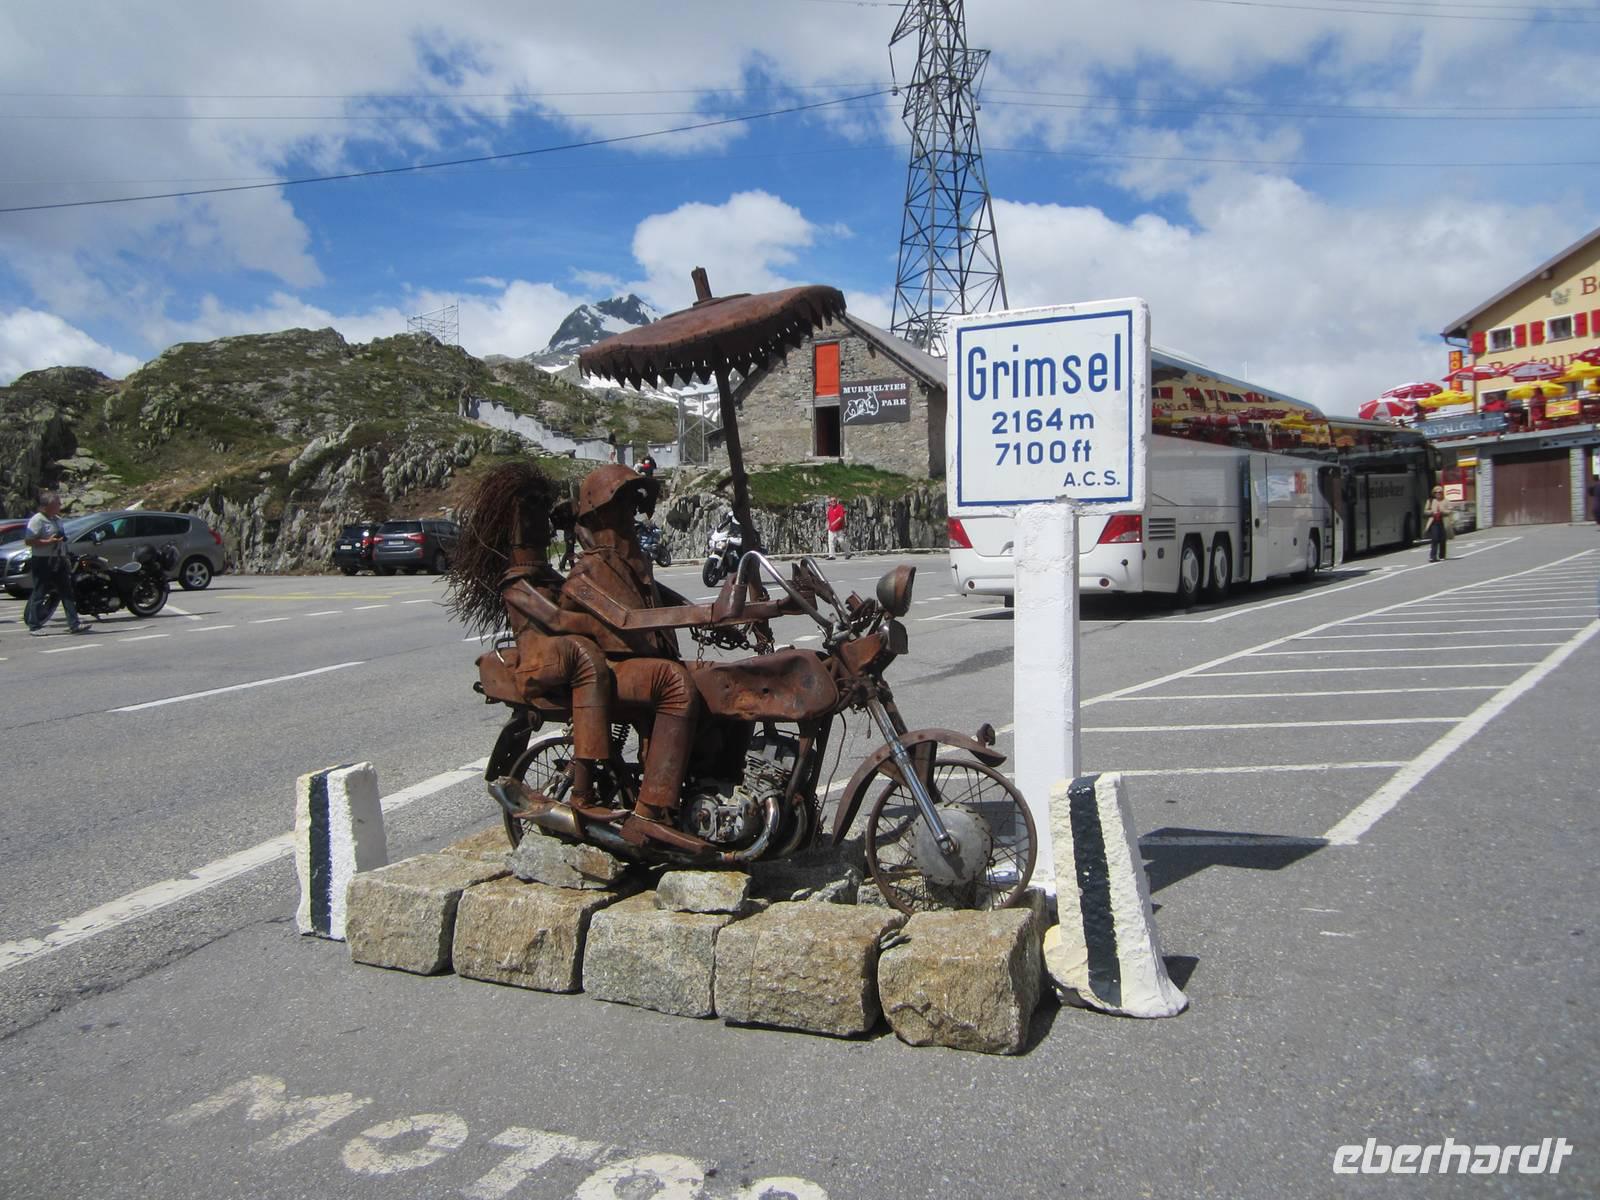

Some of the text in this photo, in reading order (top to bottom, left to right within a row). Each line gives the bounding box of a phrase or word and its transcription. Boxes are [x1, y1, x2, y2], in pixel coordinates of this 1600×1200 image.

[968, 333, 1121, 401] Grimsel
[842, 383, 907, 394] MURMELTIER
[881, 398, 907, 407] PARK
[1063, 470, 1121, 487] A.C.S.
